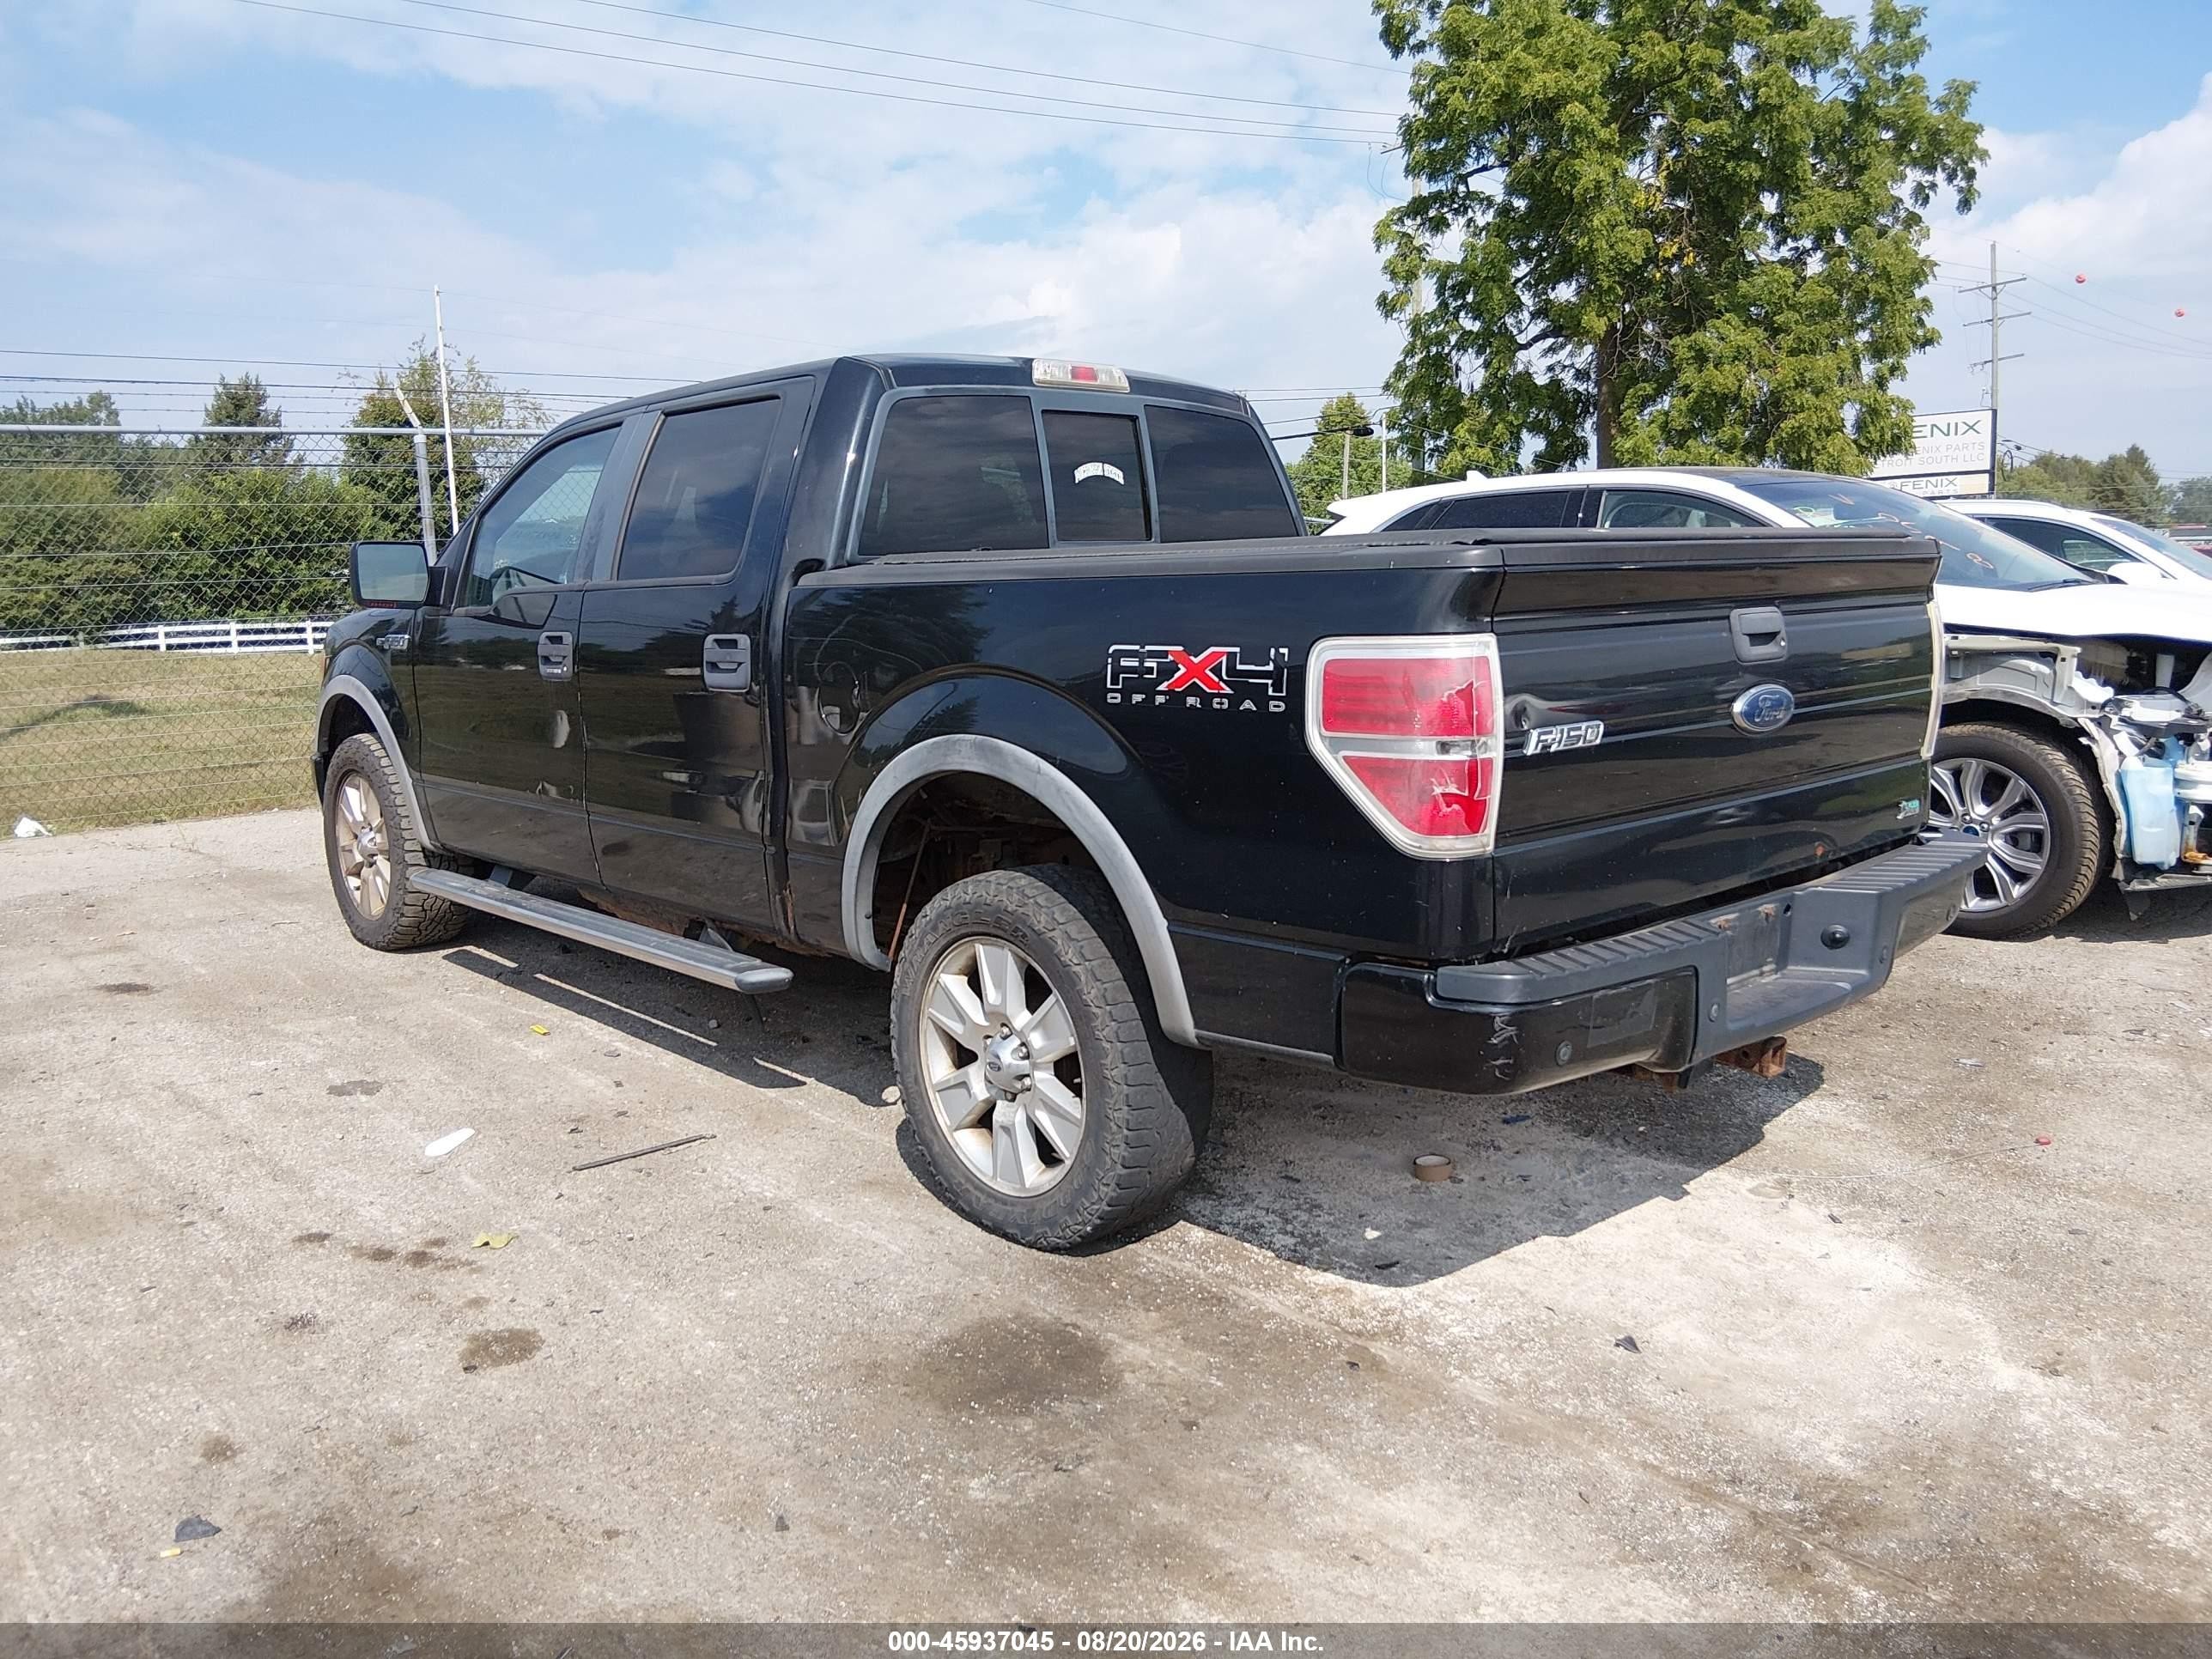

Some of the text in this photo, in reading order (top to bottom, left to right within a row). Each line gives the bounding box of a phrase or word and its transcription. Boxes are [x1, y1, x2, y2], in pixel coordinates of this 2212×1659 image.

[1912, 420, 1982, 438] ENIX
[1917, 441, 1985, 455] ENIX PARTS
[1881, 453, 1985, 467] TROIT SOUTH LLC
[1899, 477, 1958, 491] FENIX
[1107, 645, 1288, 696] FX4
[1106, 692, 1286, 712] OFF ROAD
[1754, 695, 1787, 721] Ford
